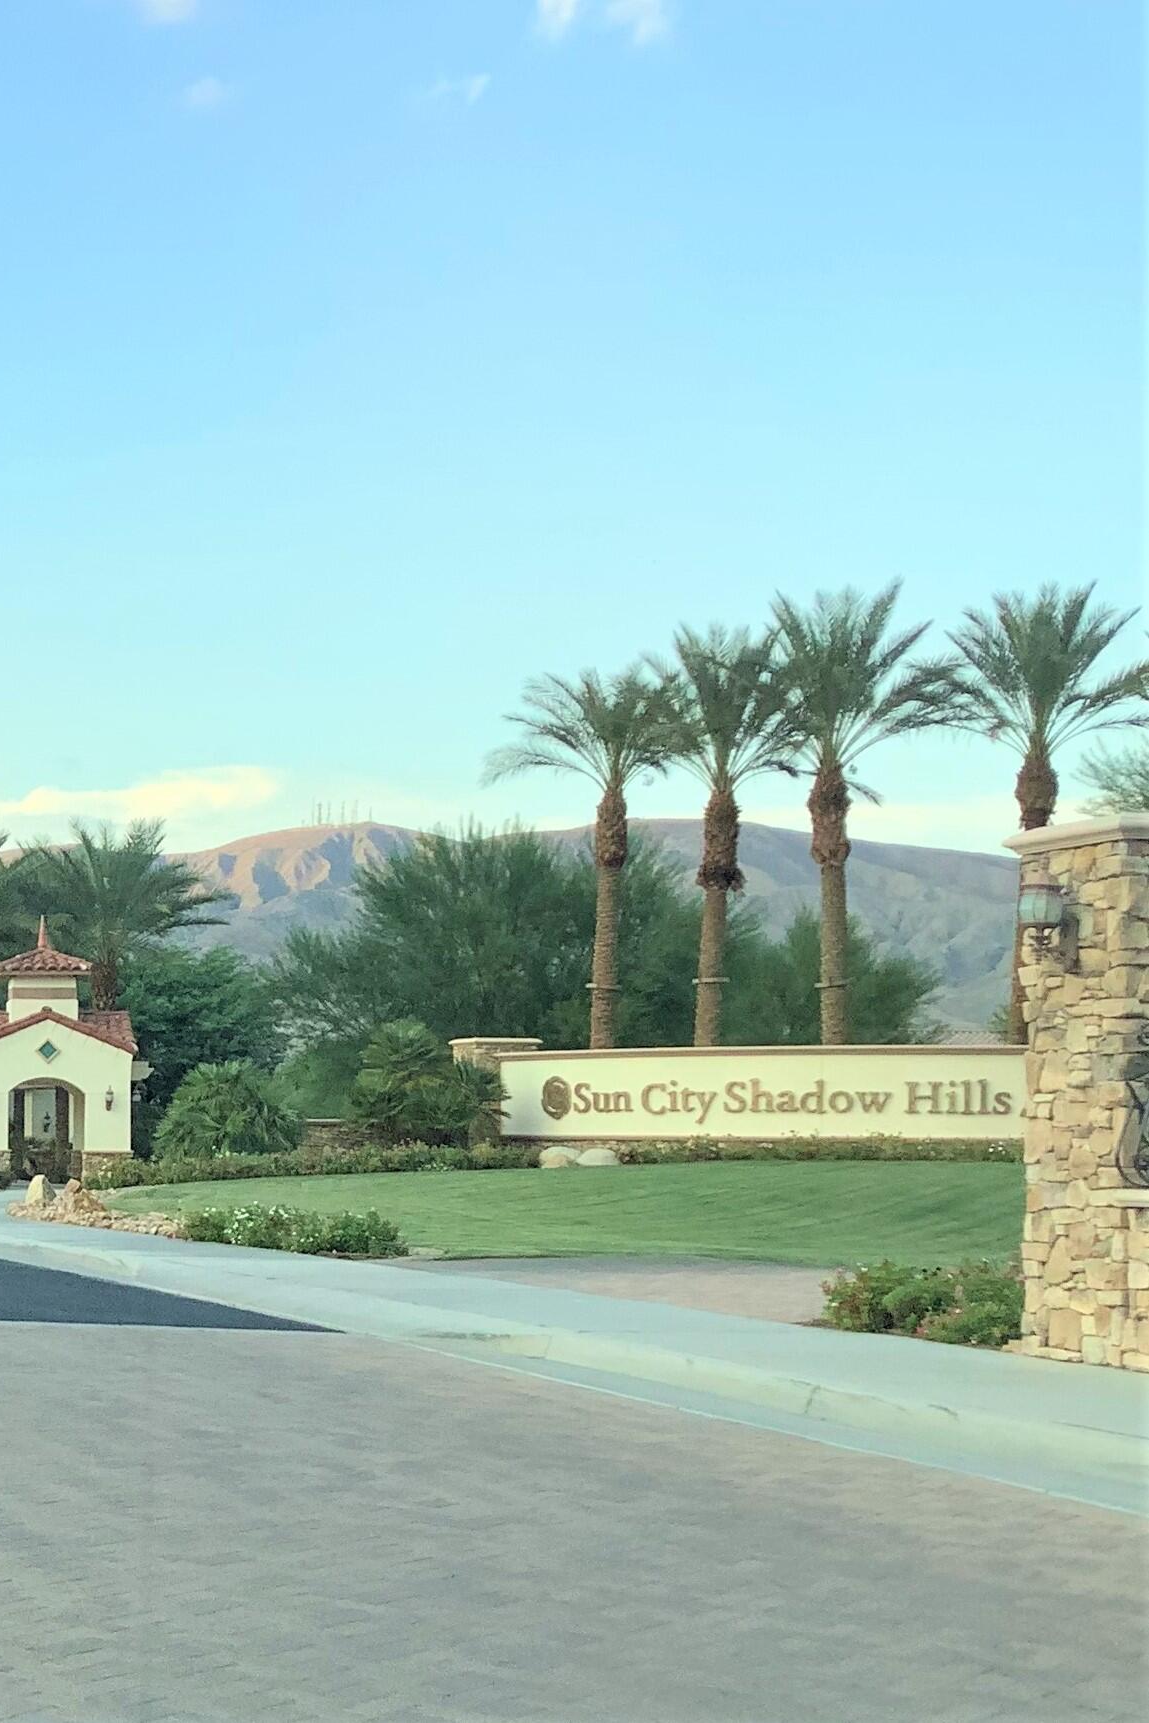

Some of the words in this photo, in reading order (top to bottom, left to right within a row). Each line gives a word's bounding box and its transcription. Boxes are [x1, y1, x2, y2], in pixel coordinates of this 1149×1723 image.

[573, 1083, 633, 1113] Sun
[641, 1079, 717, 1124] City
[724, 1078, 892, 1115] Shadow
[904, 1079, 1012, 1115] Hills
